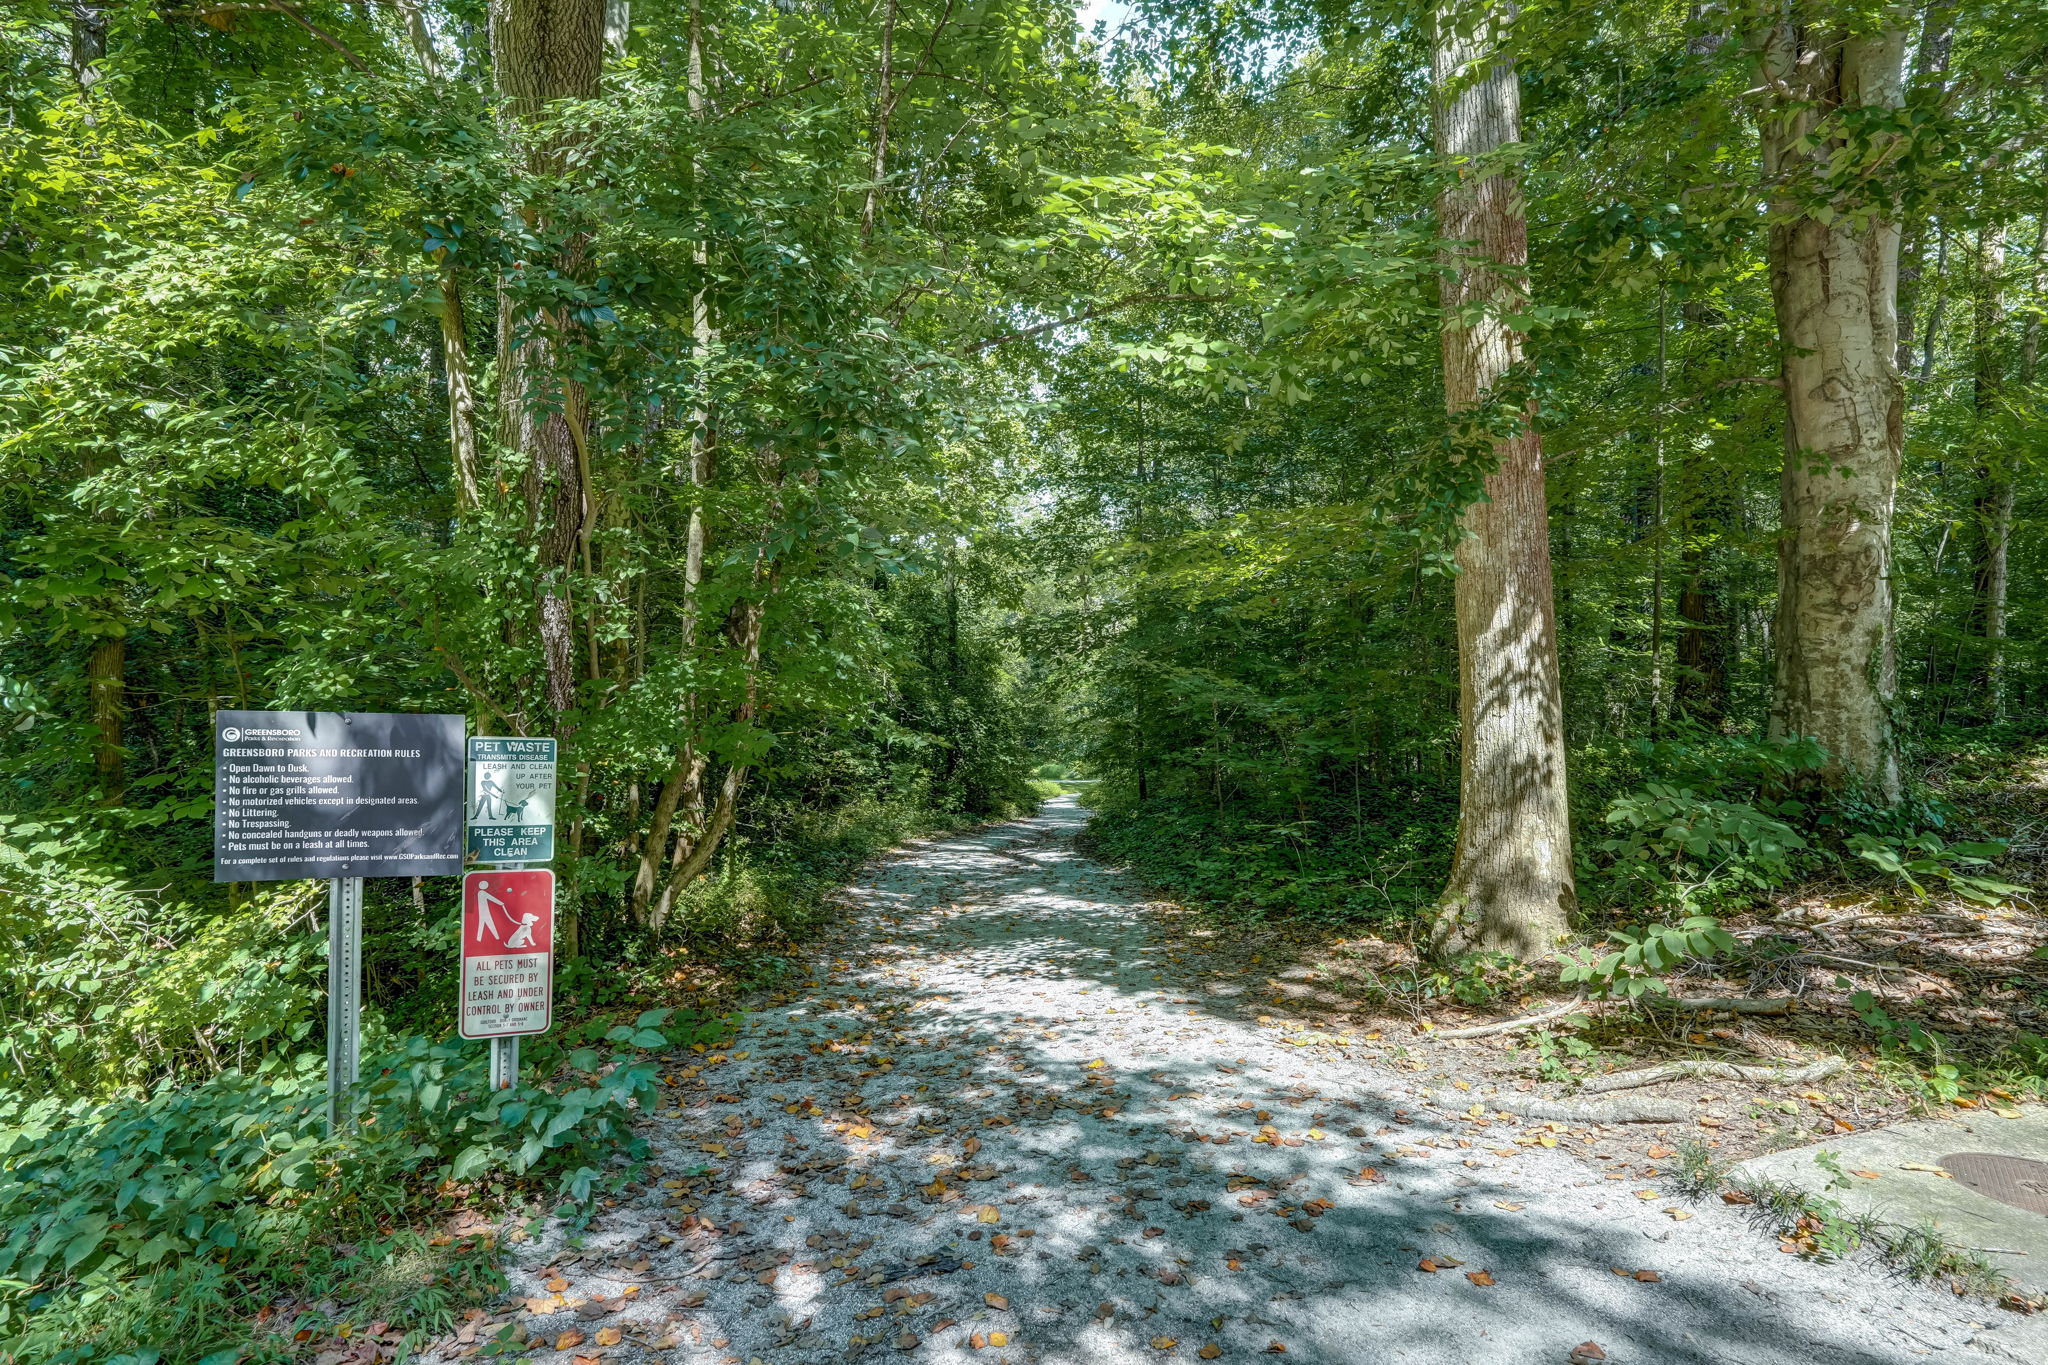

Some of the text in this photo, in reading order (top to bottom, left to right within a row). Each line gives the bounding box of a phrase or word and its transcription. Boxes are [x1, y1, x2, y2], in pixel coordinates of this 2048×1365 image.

[476, 742, 549, 752] PET WASTE
[223, 748, 284, 757] GREENSBORO
[288, 749, 317, 757] PARKS
[320, 749, 337, 757] AND
[340, 749, 392, 757] RECREATION
[229, 764, 309, 774] Open Dawn to Dusk.
[229, 774, 353, 784] No alcoholic beverages allowed.
[229, 786, 240, 795] No
[243, 786, 257, 794] fire
[286, 786, 305, 795] grills
[308, 786, 339, 794] allowed.
[229, 798, 240, 806] No
[243, 797, 283, 806] motorized
[285, 797, 316, 805] vehicles
[319, 797, 344, 806] except
[356, 796, 396, 806] designated
[229, 808, 279, 818] No Littering.
[229, 819, 291, 829] No Trespassing.
[228, 831, 239, 839] No
[242, 830, 282, 839] concealed
[285, 830, 322, 839] handguns
[335, 829, 359, 838] deadly
[361, 830, 393, 838] weapons
[395, 828, 424, 836] allowed.
[475, 828, 513, 836] PLEASE
[228, 842, 246, 851] Pets
[272, 841, 281, 850] be
[303, 841, 322, 849] leash
[494, 848, 527, 856] CLEAN
[476, 958, 537, 971] ALL PETS MUST
[474, 973, 538, 986] BE SECURED BY
[468, 987, 543, 1001] LEASH AND UNDER
[466, 1002, 544, 1016] CONTROL BY OWNER
